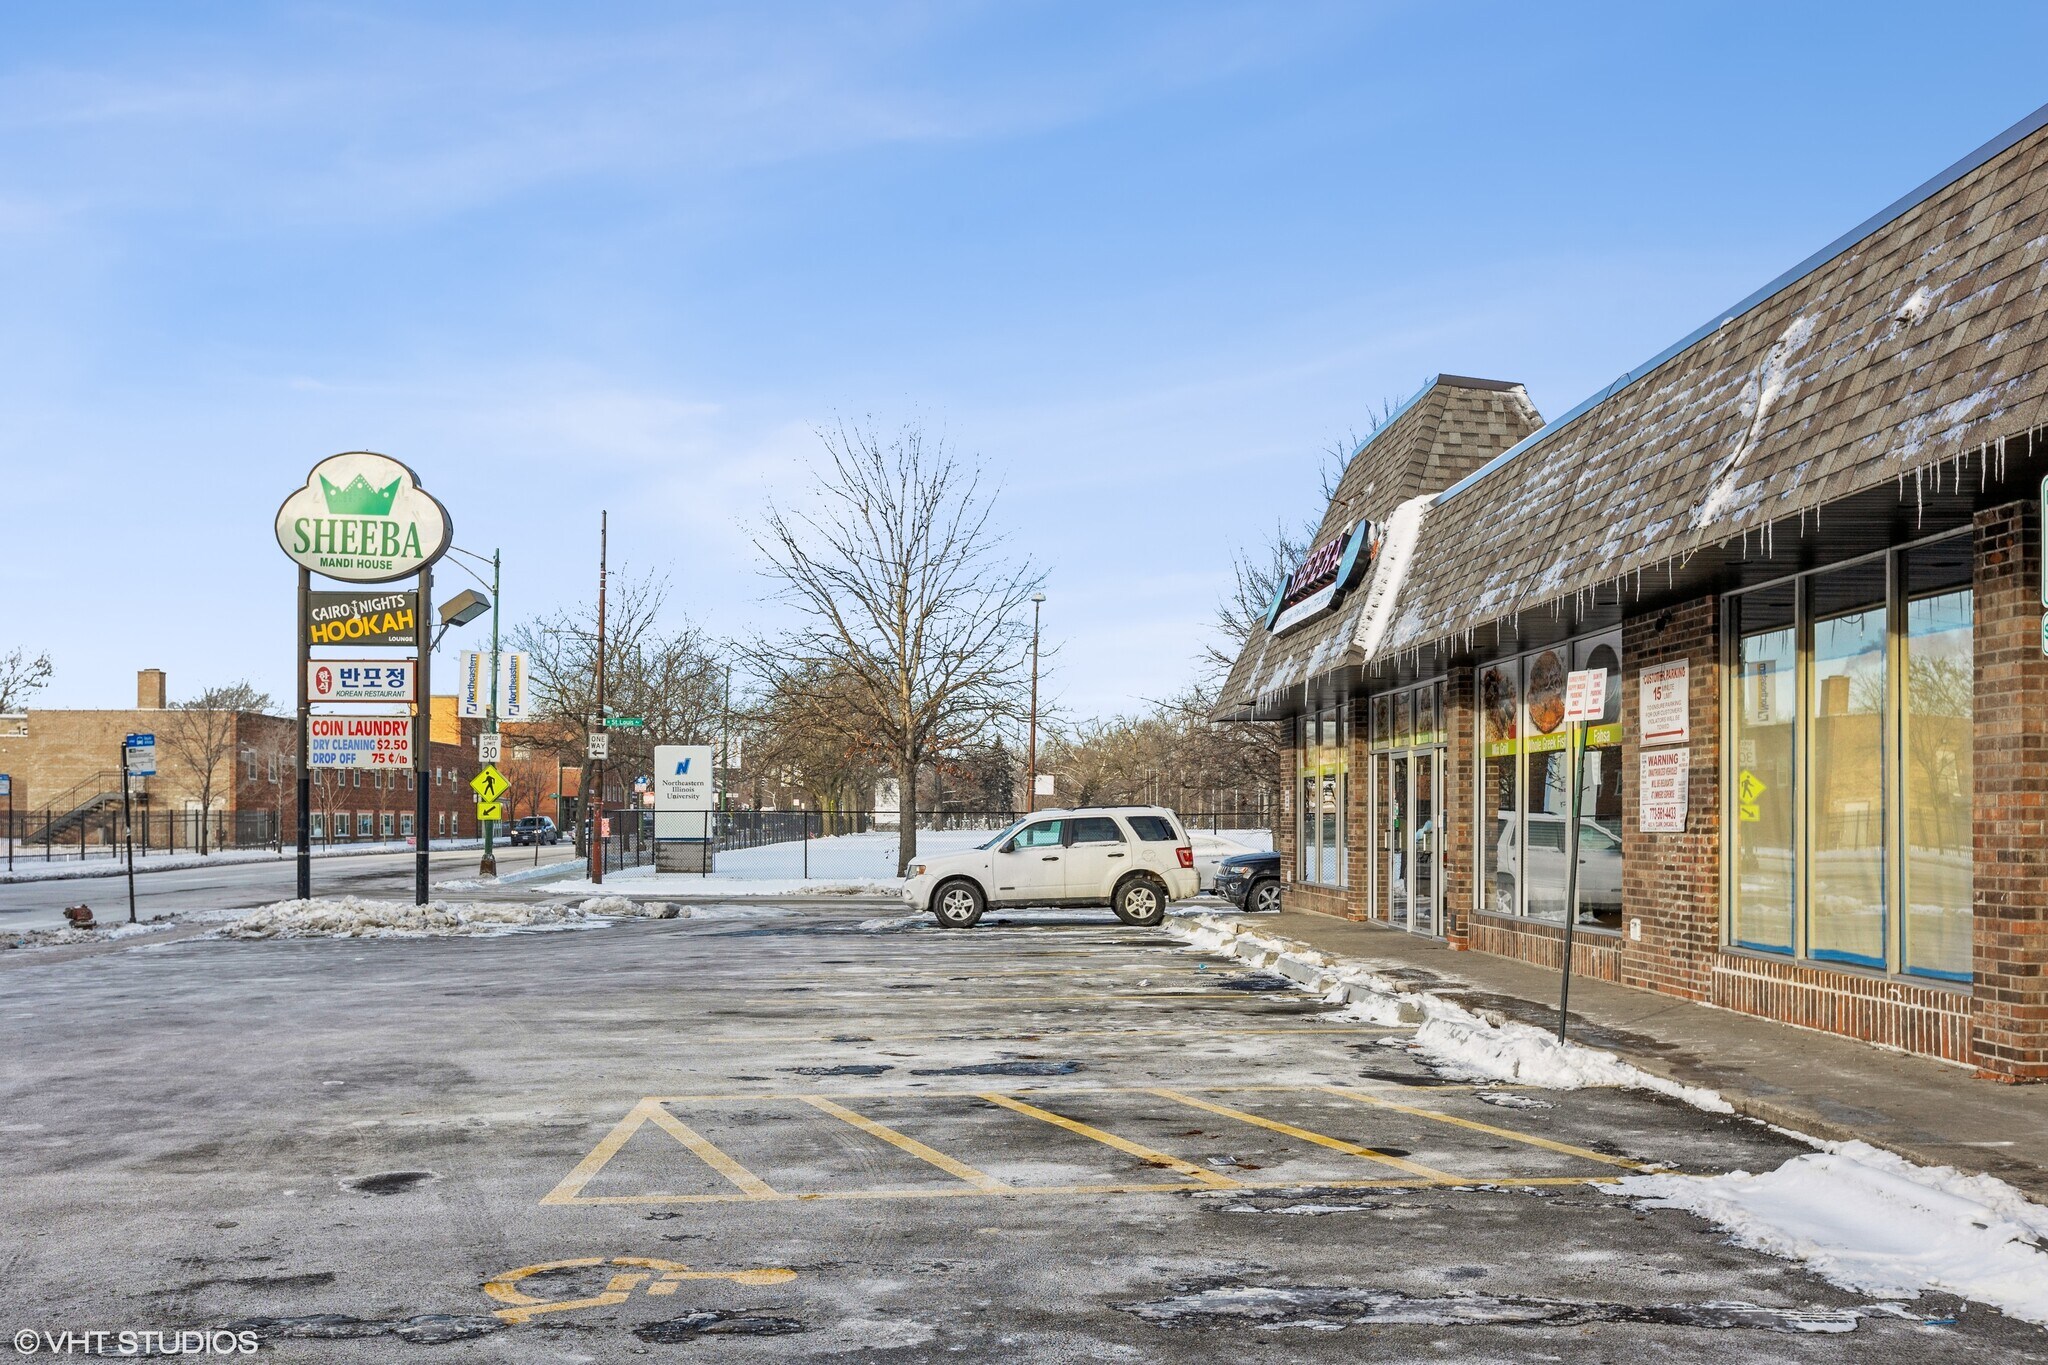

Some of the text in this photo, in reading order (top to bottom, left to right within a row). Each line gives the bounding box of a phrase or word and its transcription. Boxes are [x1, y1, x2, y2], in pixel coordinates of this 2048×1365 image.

[294, 517, 423, 559] SHEEBA
[320, 557, 393, 570] MANDI HOUSE
[312, 594, 406, 621] CAIRO NIGHTS
[310, 609, 414, 643] HOOKAH
[340, 668, 405, 688] 반포정
[467, 654, 477, 703] Northeastern
[508, 655, 518, 705] Northeastern
[336, 690, 406, 698] KOREAN RESTAURANT
[1653, 686, 1662, 701] 15
[312, 720, 409, 737] COIN LAUNDRY
[312, 738, 408, 752] DRY CLEANING $2.50
[482, 747, 498, 758] 30
[312, 752, 337, 764] DROP
[339, 752, 357, 764] OFF
[371, 753, 385, 764] 75
[1648, 753, 1679, 767] WARNING
